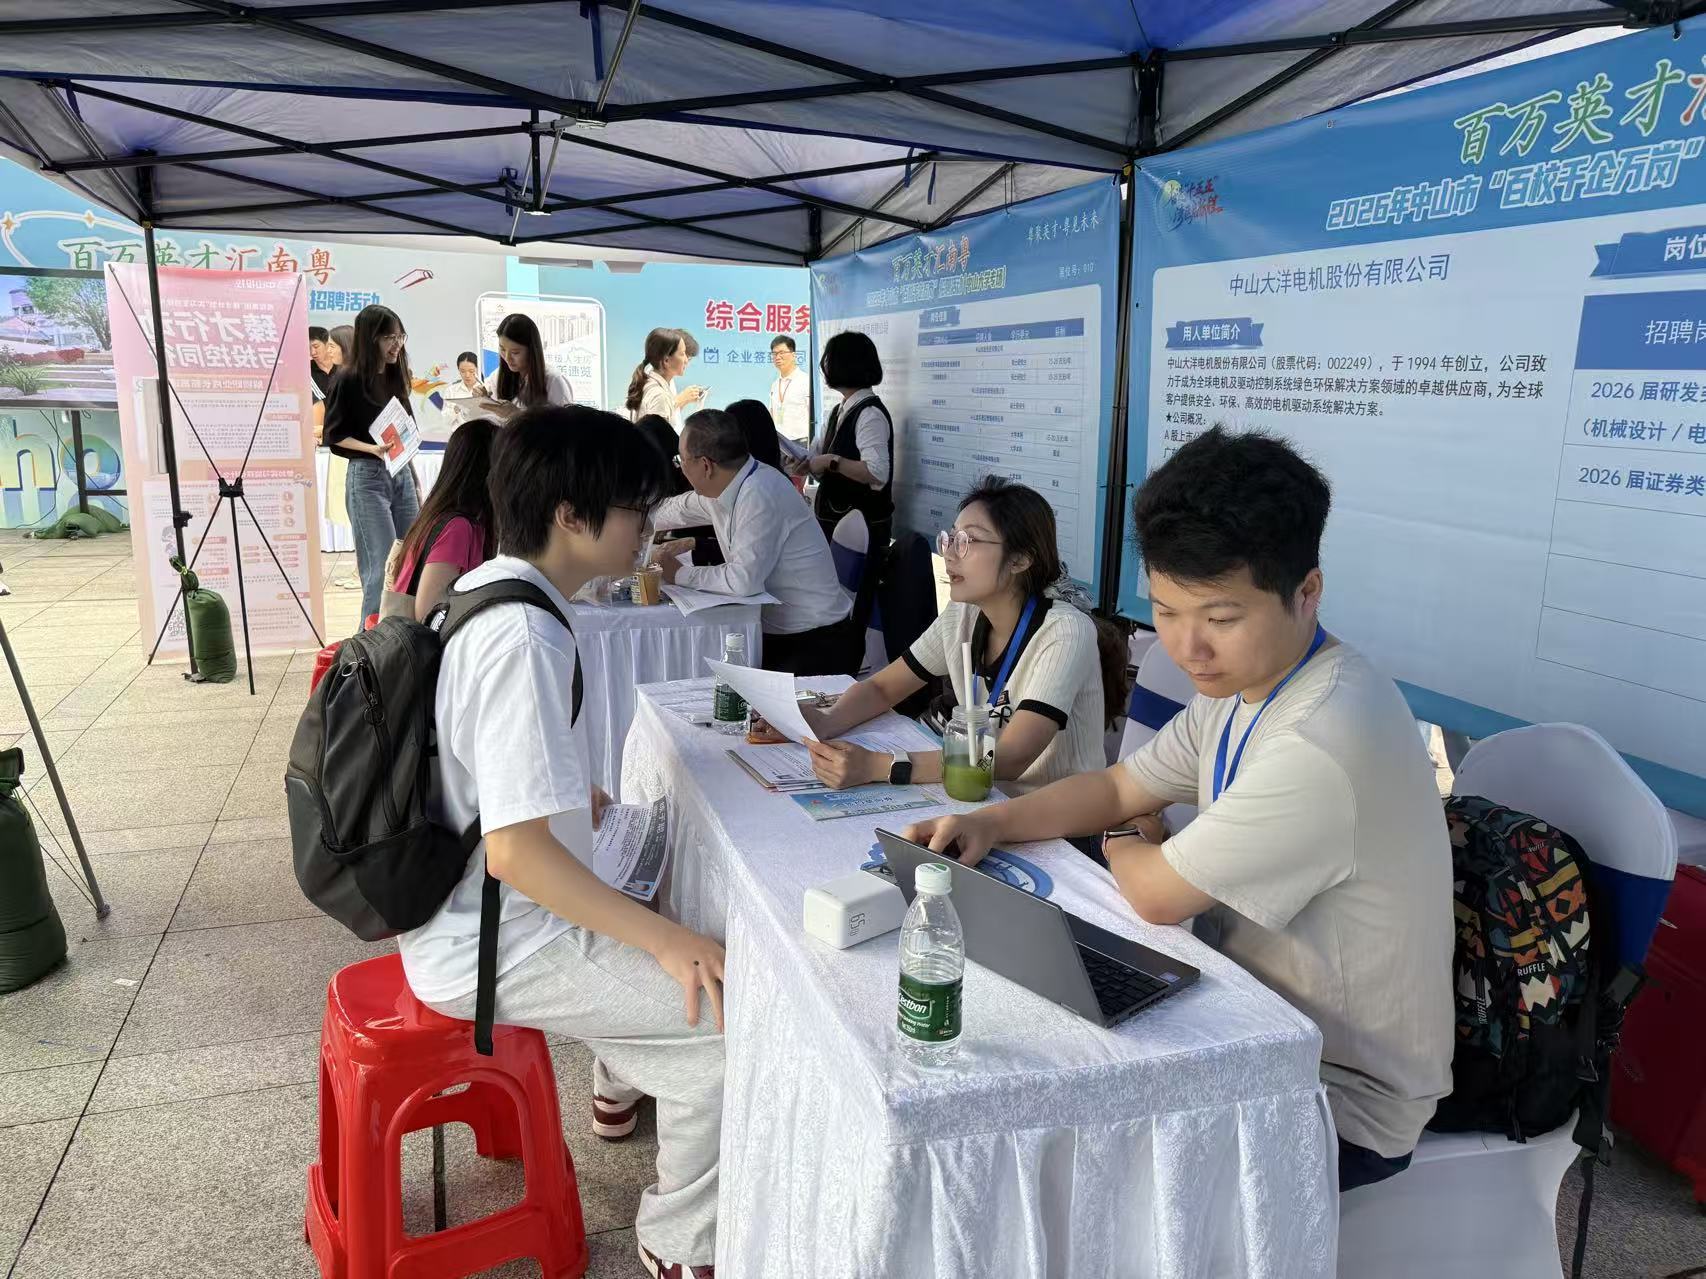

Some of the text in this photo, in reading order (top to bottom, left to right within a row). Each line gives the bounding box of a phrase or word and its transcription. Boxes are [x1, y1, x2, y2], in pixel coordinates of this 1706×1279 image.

[1229, 253, 1450, 298] 中山大洋电机股份有限公司
[309, 290, 380, 312] 招聘活动
[1183, 323, 1240, 341] 用人单位简介
[1408, 356, 1437, 370] 1994
[1440, 354, 1547, 372] 年创立，公司致
[1591, 381, 1635, 399] 2026
[1578, 467, 1705, 497] 2026 届证券类
[1517, 962, 1546, 977] RUFFLE
